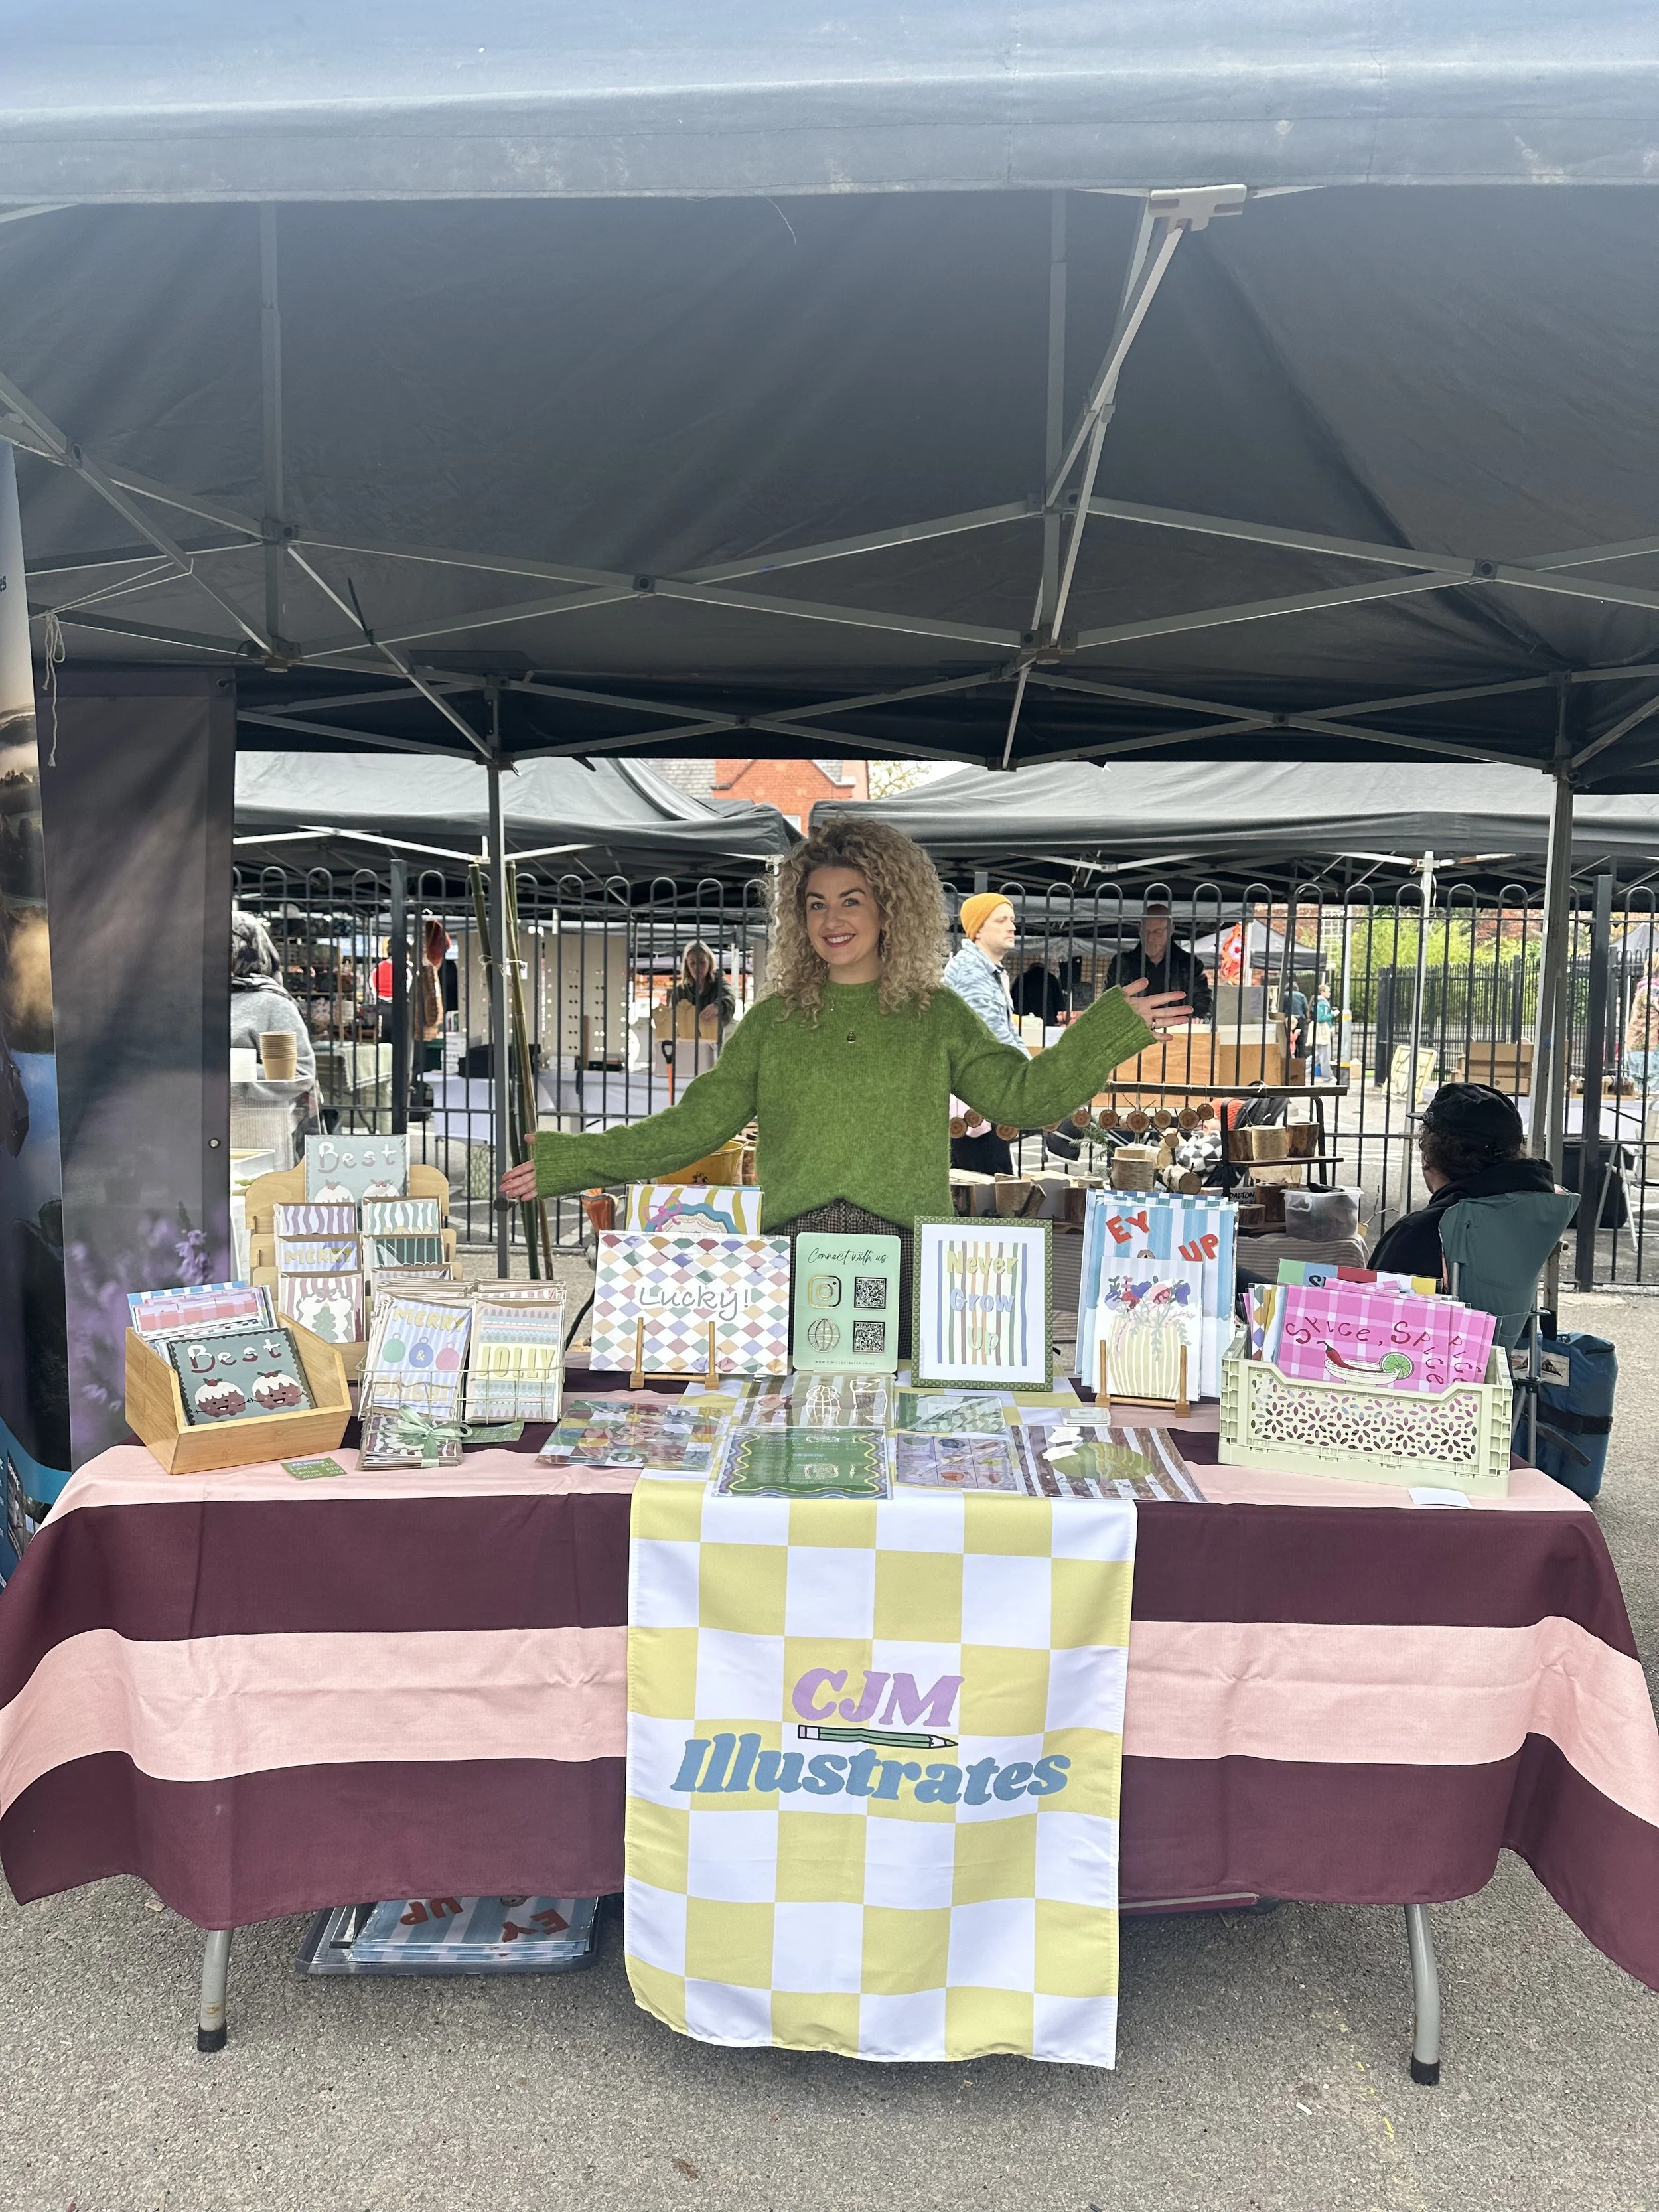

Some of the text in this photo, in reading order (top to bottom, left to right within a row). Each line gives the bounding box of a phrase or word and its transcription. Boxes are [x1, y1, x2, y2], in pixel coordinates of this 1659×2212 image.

[317, 1142, 396, 1173] Best
[1106, 1209, 1219, 1261] EY UP
[285, 1246, 352, 1265] MERRY
[808, 1248, 889, 1265] Connect with us
[947, 1250, 1019, 1274] Never
[639, 1286, 749, 1321] Lucky!
[950, 1288, 1015, 1312] Grow
[392, 1308, 467, 1333] MERRY
[416, 1350, 425, 1361] &
[967, 1326, 999, 1355] Up
[187, 1339, 282, 1374] Best
[477, 1346, 556, 1378] JOLLY
[375, 1375, 449, 1405] BRIGHT
[792, 1668, 965, 1727] CJM
[670, 1733, 1072, 1806] Illustrates
[399, 1897, 571, 1943] EY UP
